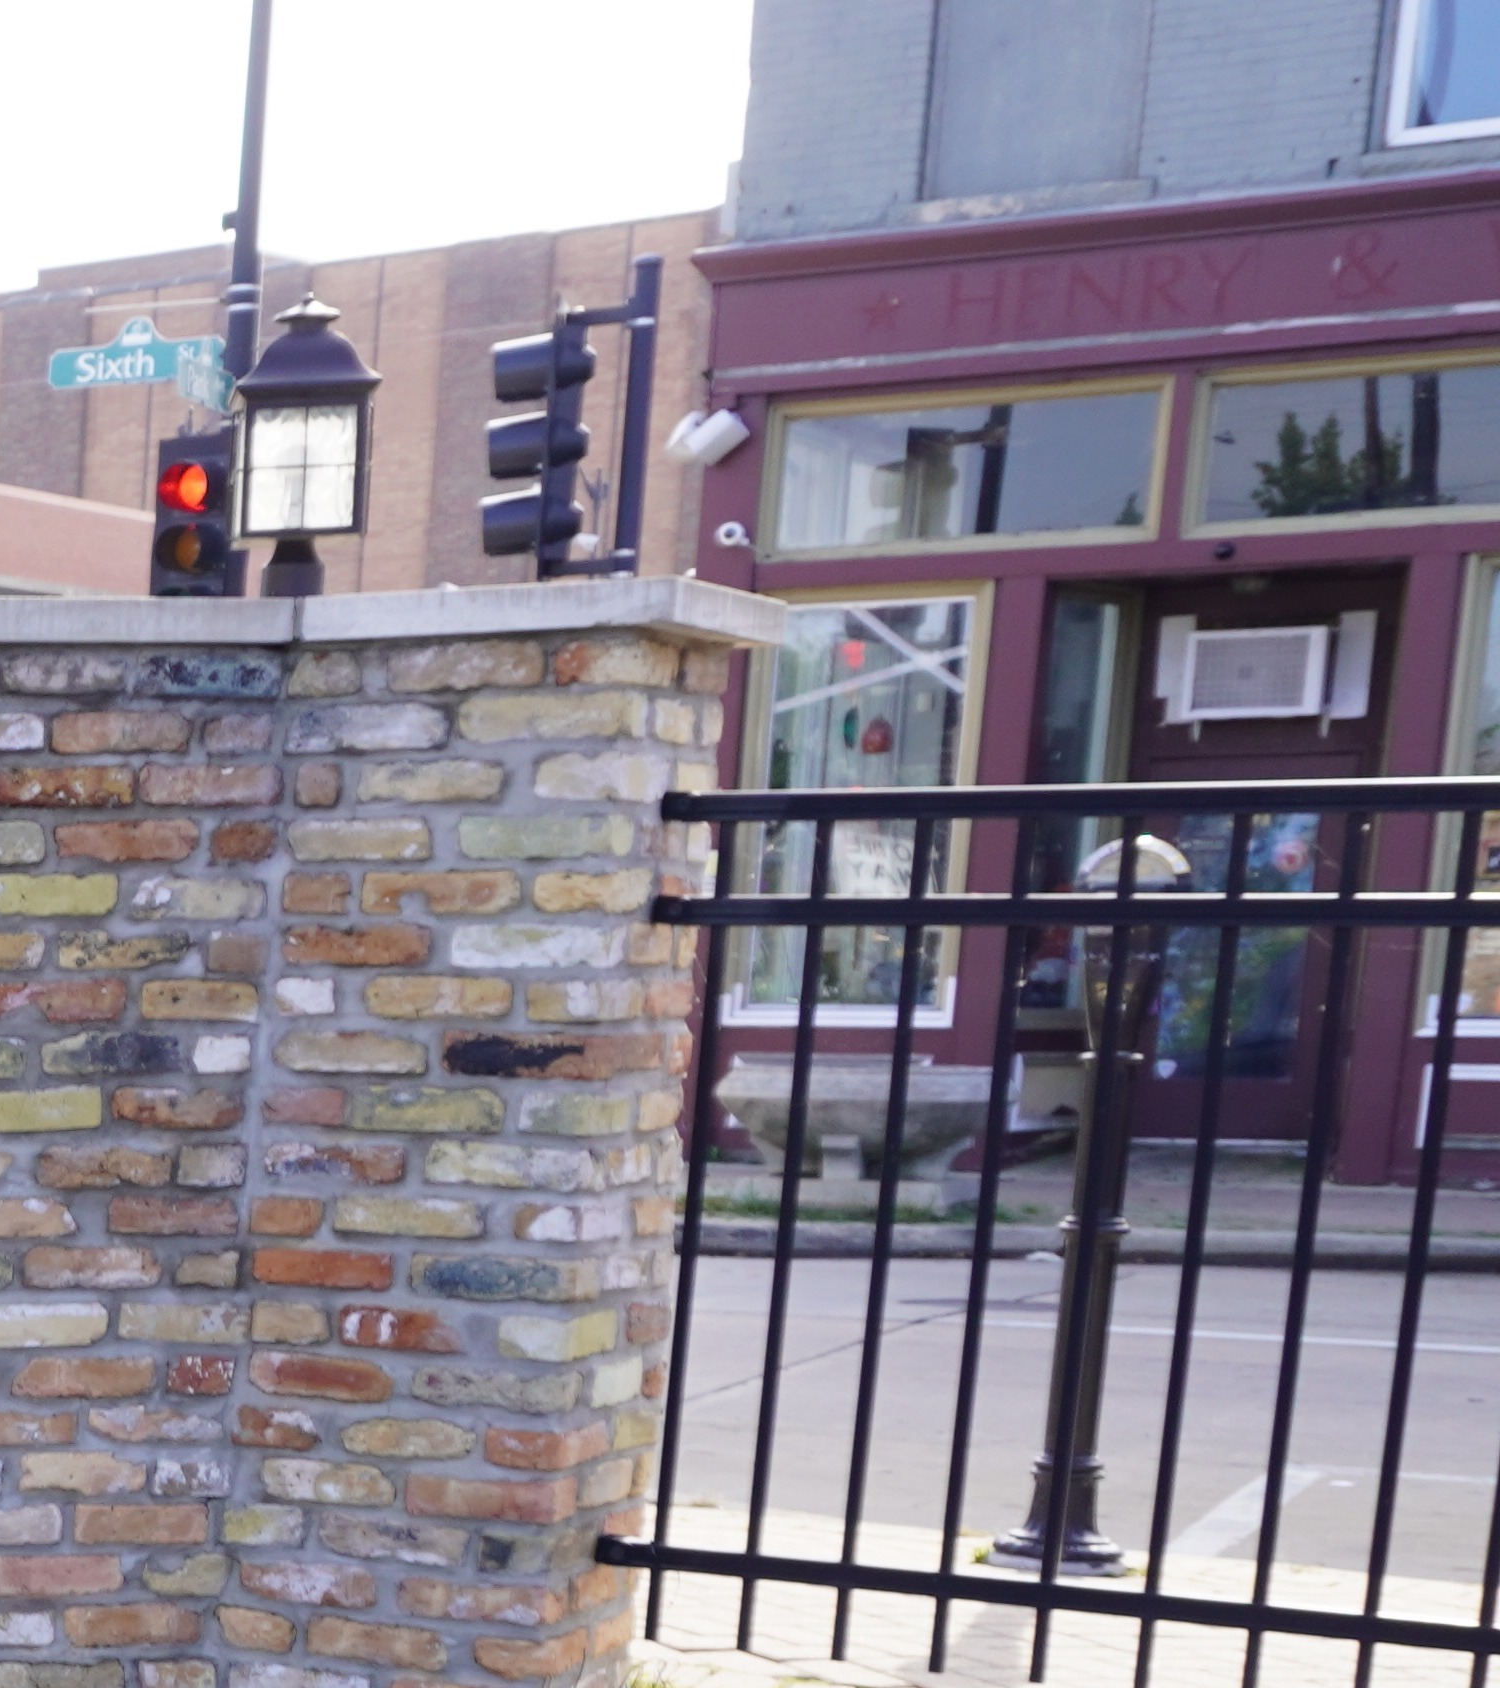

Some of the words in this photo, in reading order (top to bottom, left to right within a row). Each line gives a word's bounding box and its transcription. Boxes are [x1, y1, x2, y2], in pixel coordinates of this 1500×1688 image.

[944, 239, 1265, 333] HENRY
[1331, 229, 1399, 300] &
[75, 349, 155, 384] Sixth
